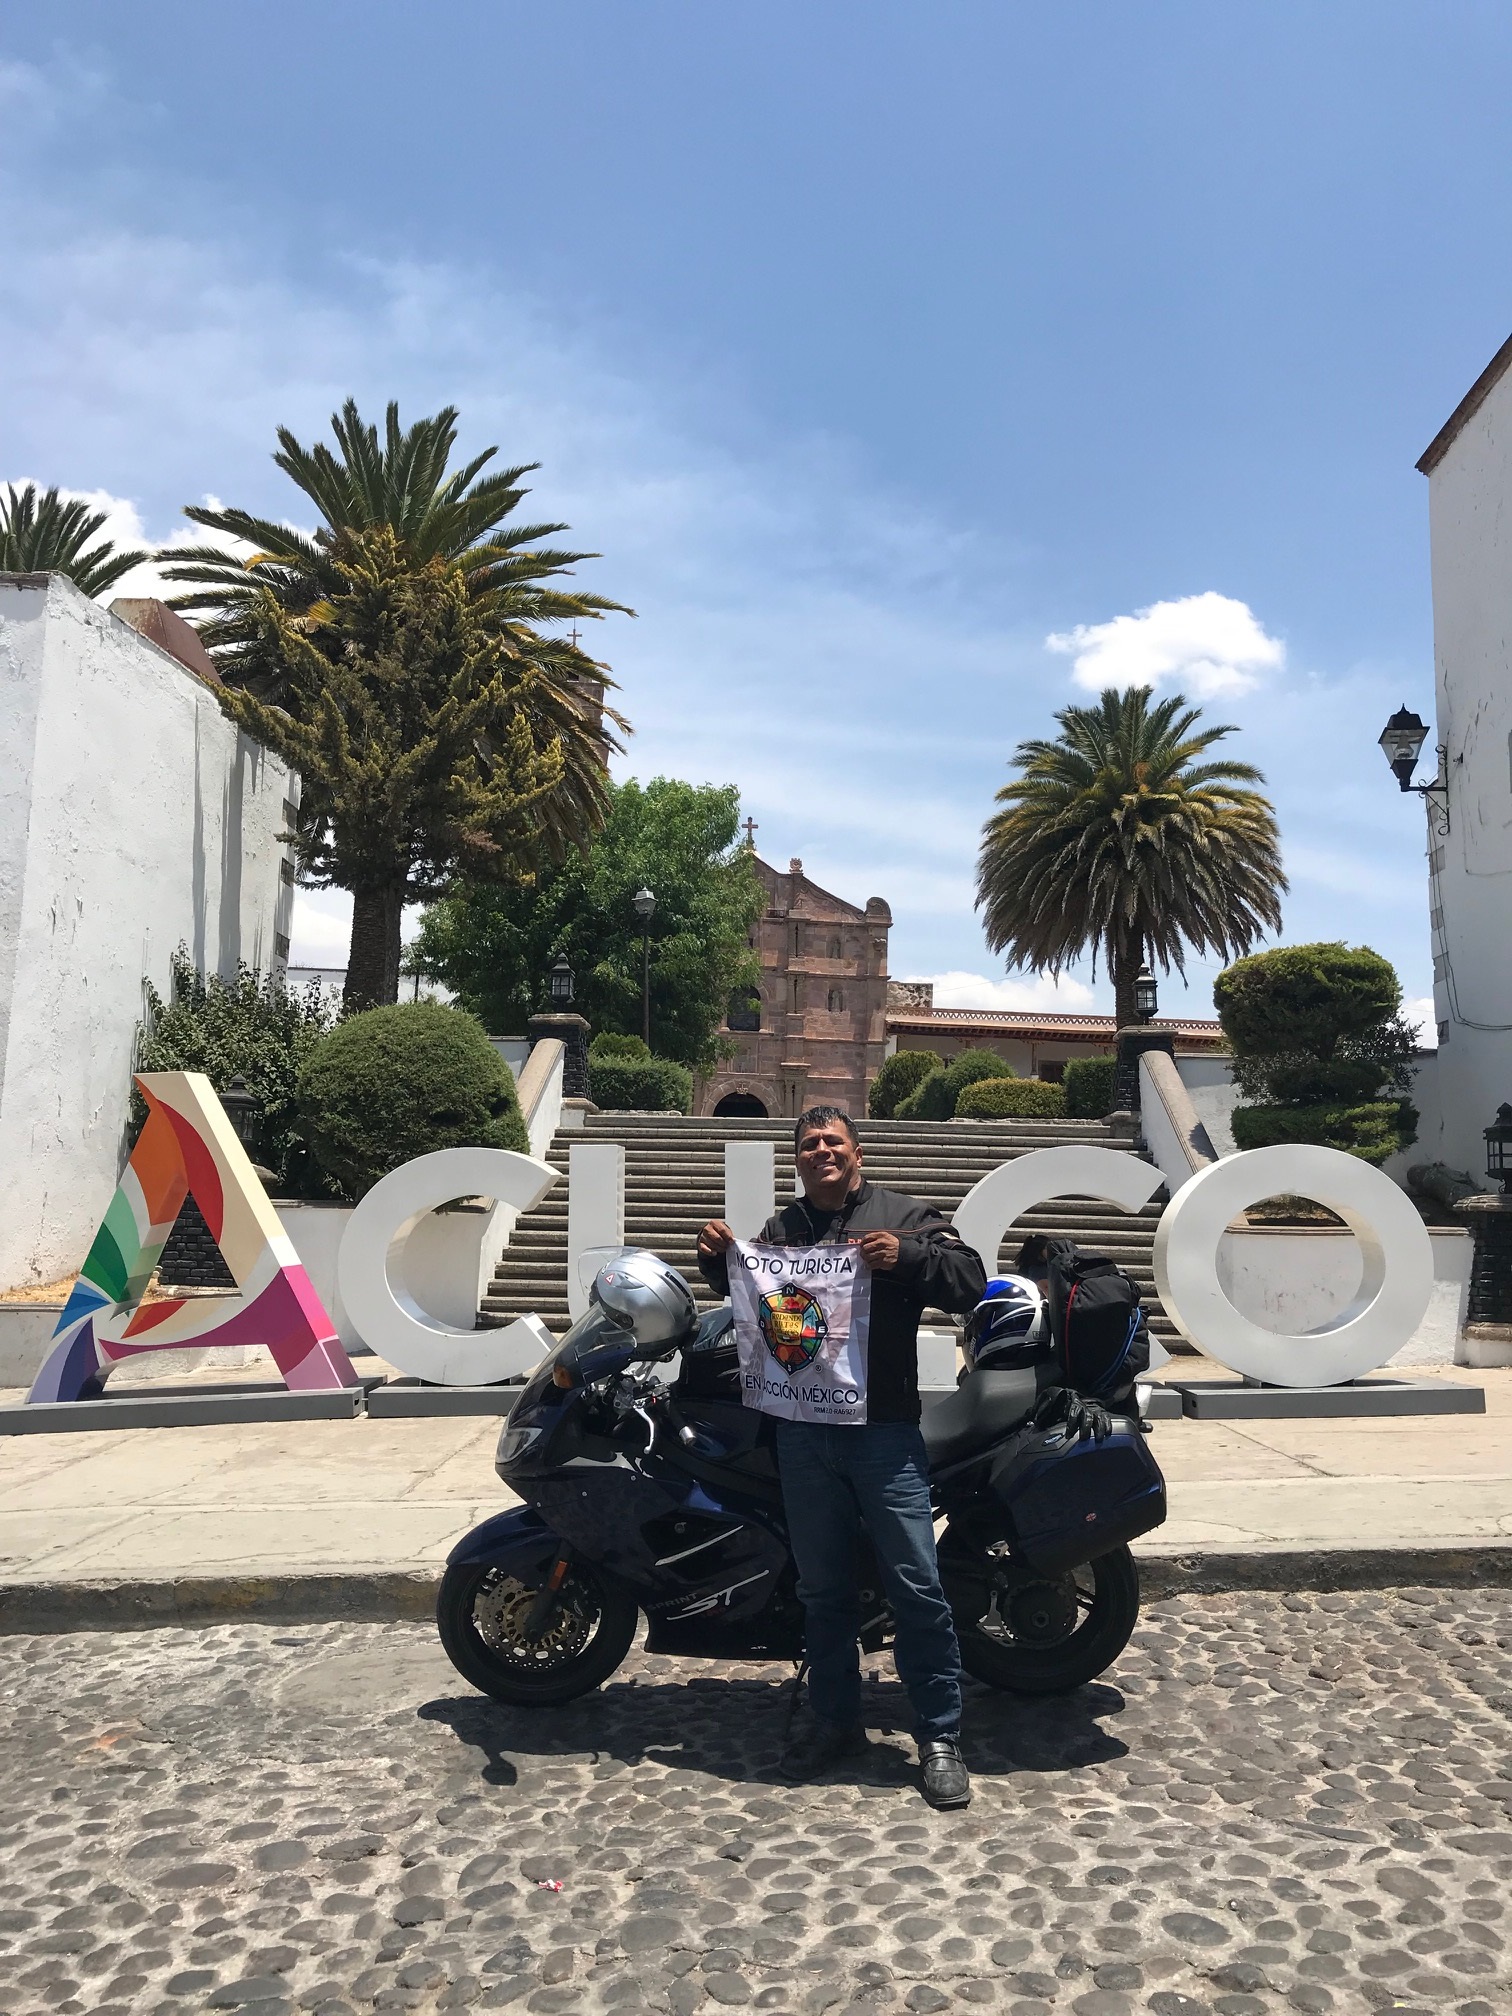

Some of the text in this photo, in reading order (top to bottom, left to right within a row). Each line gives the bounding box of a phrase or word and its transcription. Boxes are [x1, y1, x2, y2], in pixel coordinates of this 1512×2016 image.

[28, 1072, 1433, 1403] ACUCO
[736, 1252, 852, 1276] MOTO TURISTA
[785, 1286, 794, 1295] N
[745, 1375, 761, 1390] EN
[802, 1384, 859, 1404] MÉXICO
[647, 1592, 698, 1610] SPRINT
